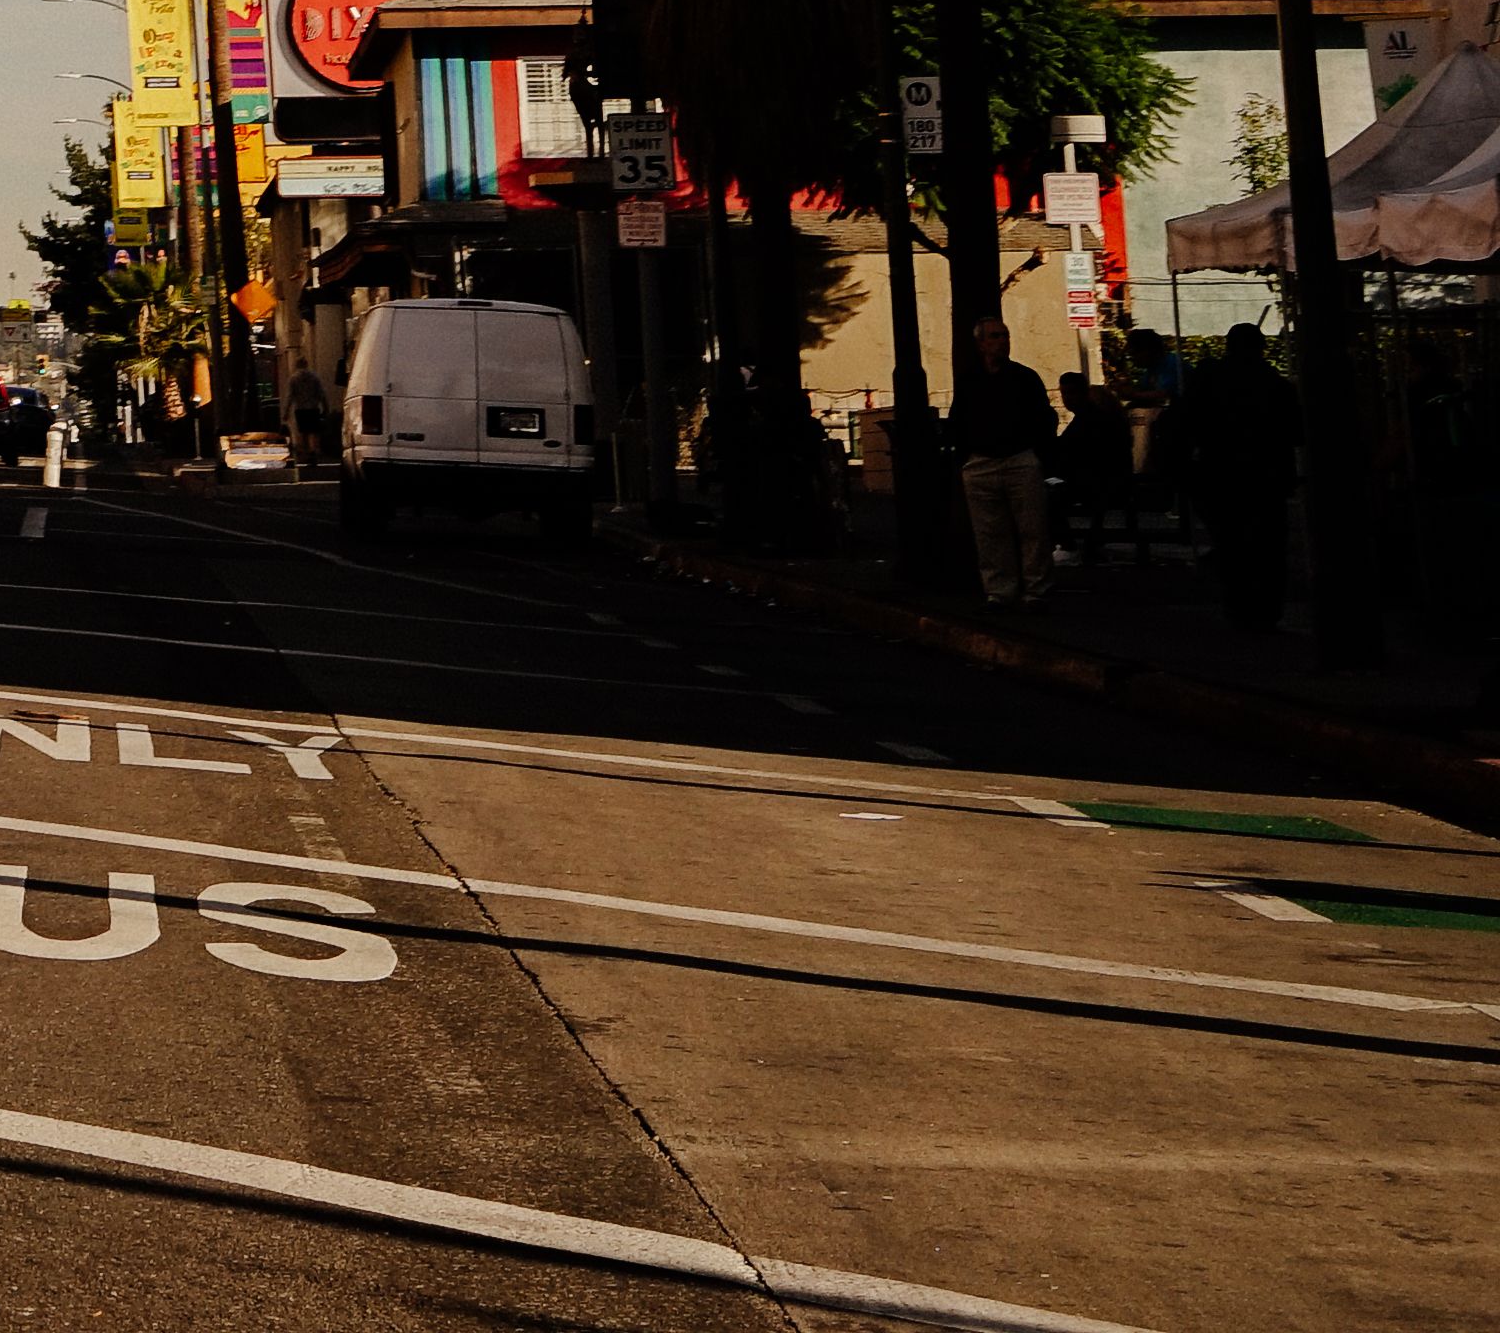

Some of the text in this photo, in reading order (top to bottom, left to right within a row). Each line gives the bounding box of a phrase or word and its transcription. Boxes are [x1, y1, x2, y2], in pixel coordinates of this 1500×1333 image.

[612, 120, 667, 133] SPEED
[908, 119, 935, 133] 180
[618, 137, 663, 150] LIMIT
[909, 135, 936, 149] 217
[618, 155, 669, 184] 35
